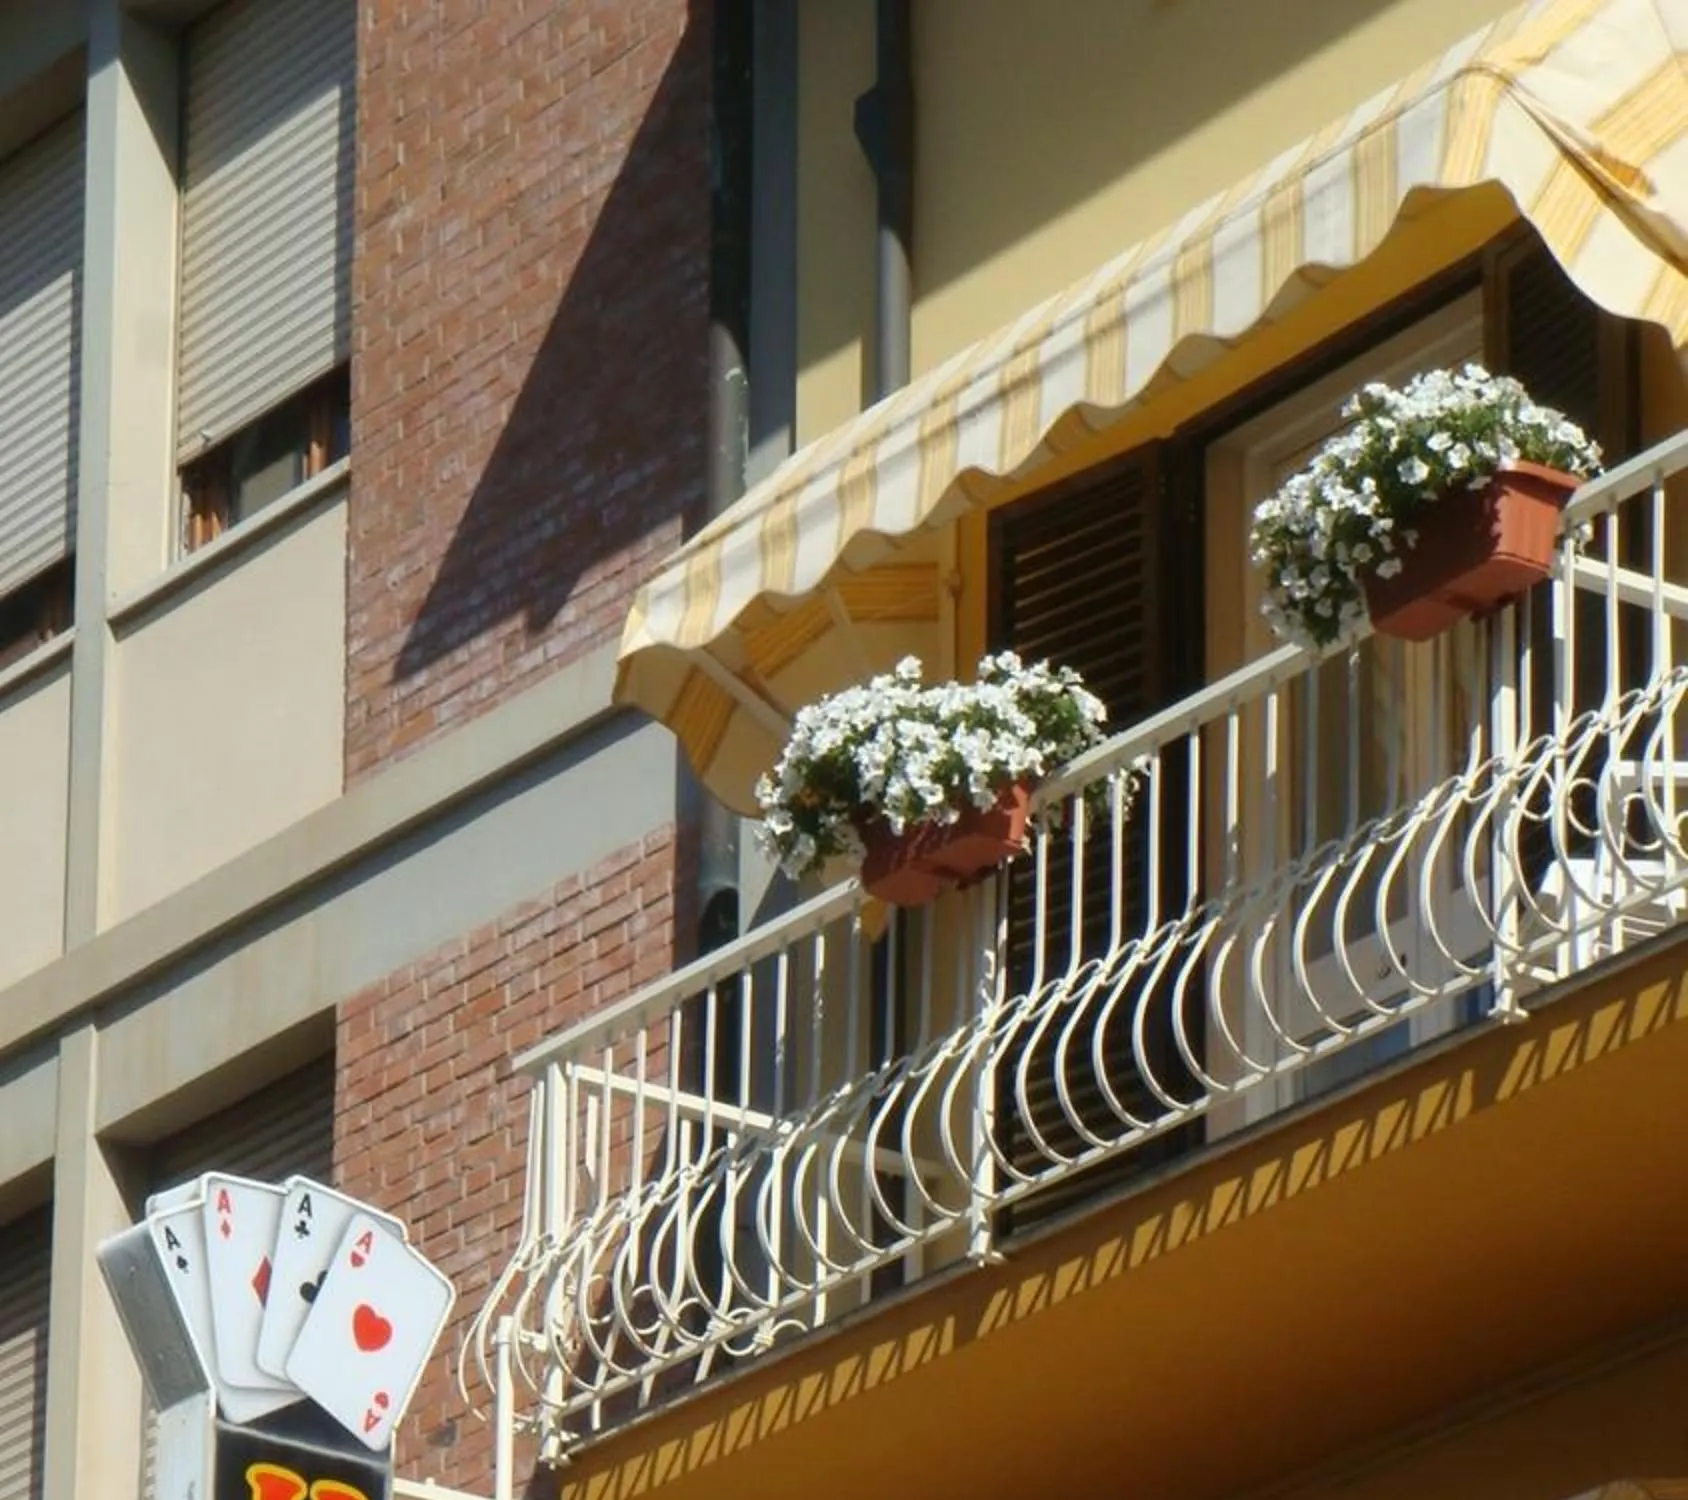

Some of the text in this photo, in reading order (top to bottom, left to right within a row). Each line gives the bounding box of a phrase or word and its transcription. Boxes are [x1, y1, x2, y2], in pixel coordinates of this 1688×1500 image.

[216, 1188, 232, 1214] A
[298, 1194, 313, 1218] A
[164, 1226, 181, 1250] A
[356, 1231, 373, 1254] A
